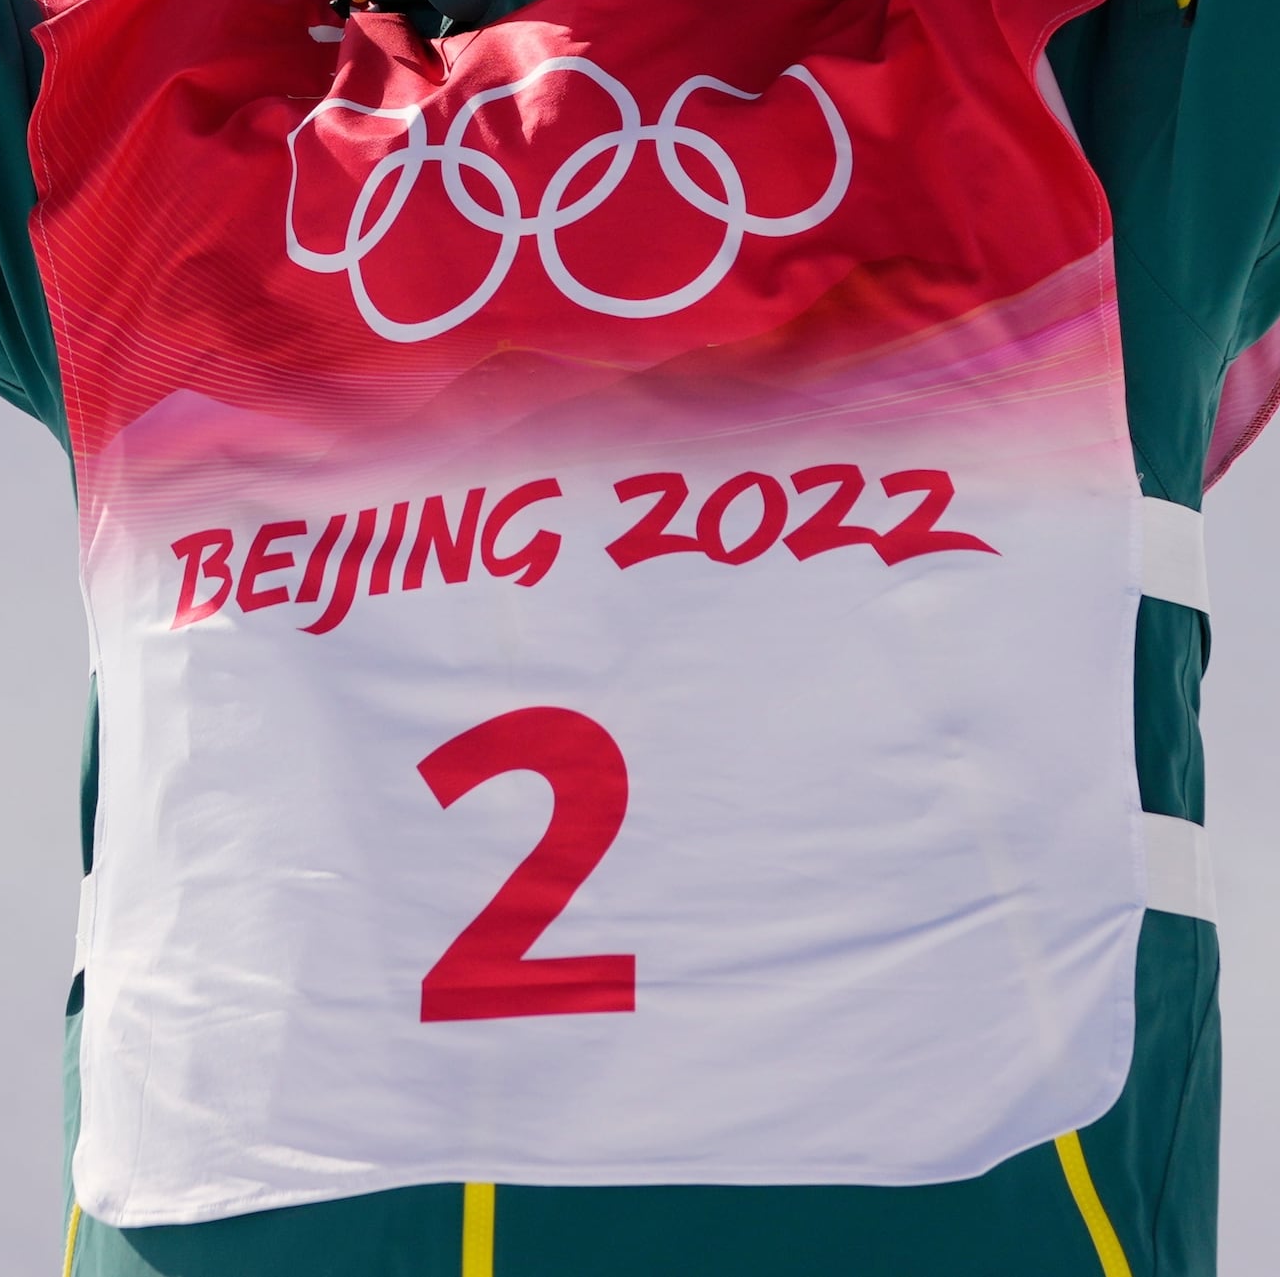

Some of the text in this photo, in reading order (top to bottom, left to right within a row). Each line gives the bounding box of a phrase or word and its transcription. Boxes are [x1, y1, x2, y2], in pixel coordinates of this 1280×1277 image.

[170, 463, 1003, 635] BEIJING 2022
[417, 705, 636, 1022] 2
